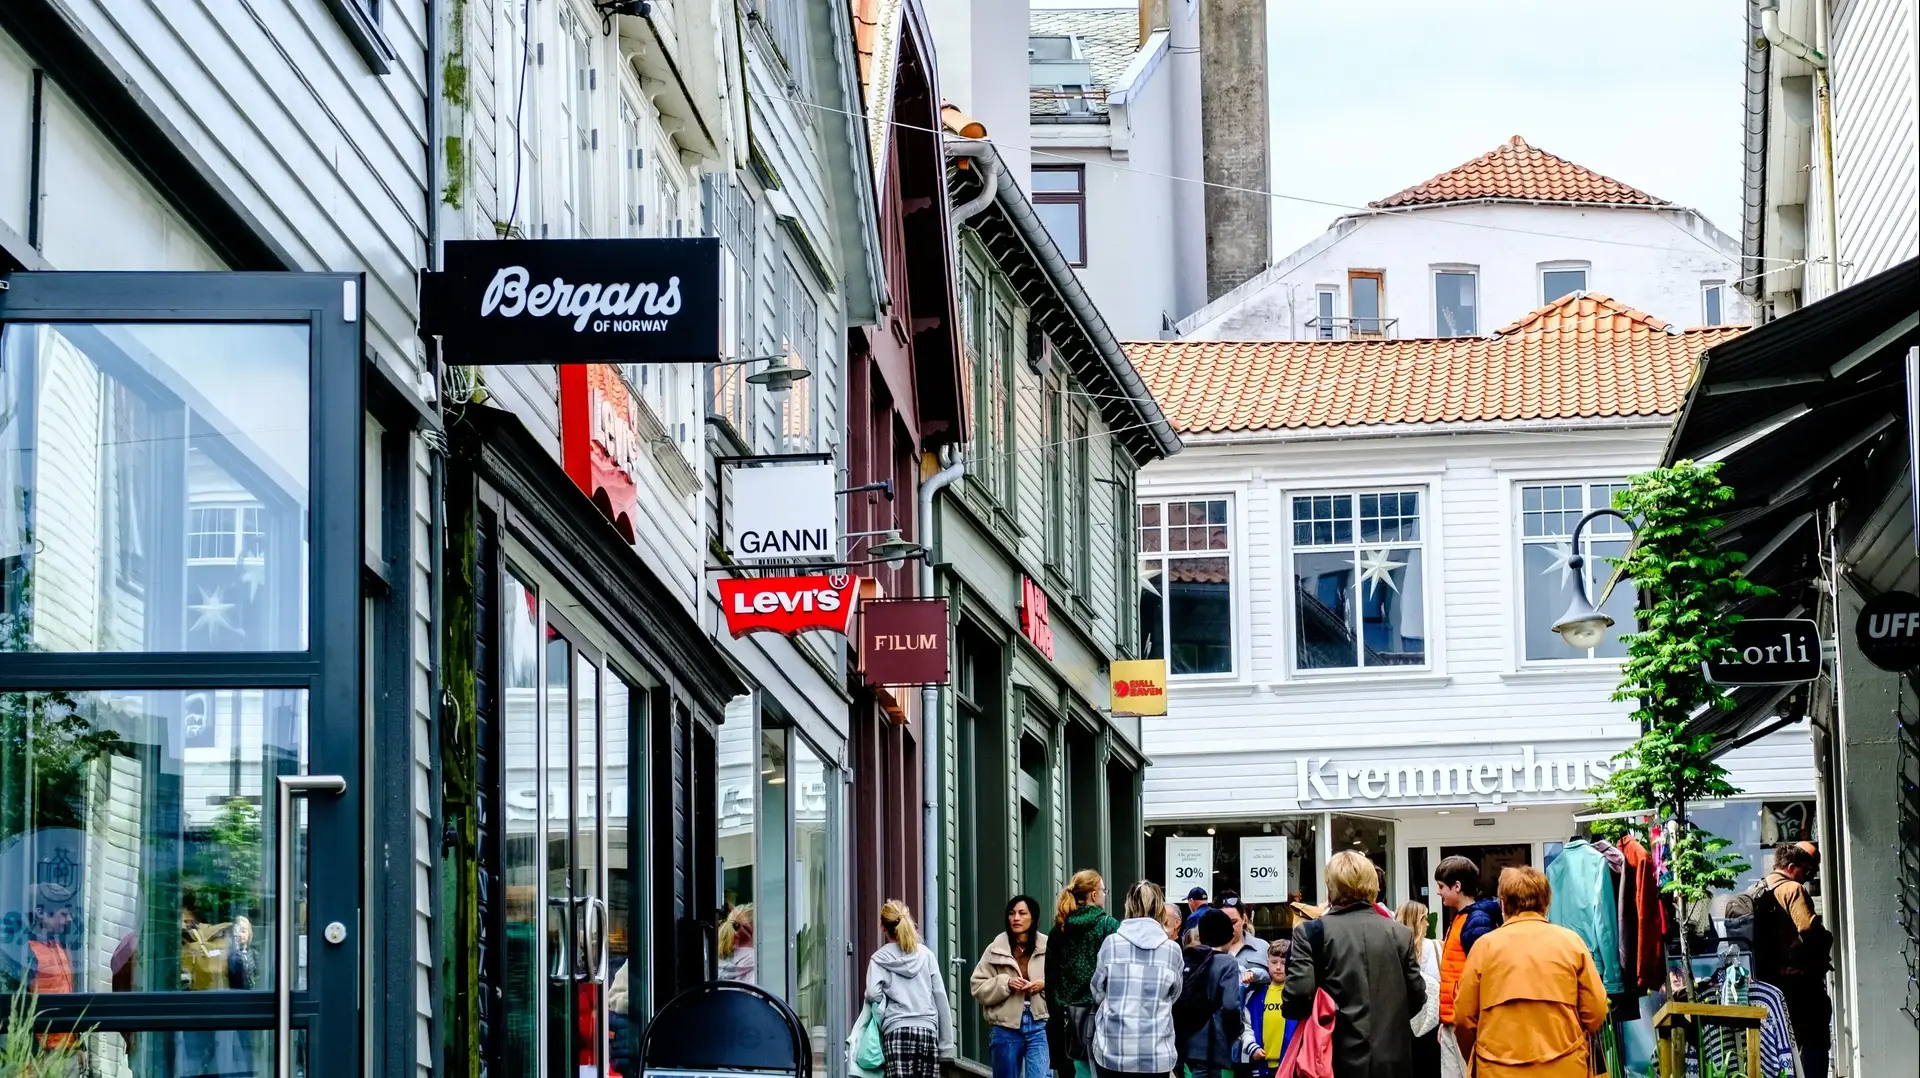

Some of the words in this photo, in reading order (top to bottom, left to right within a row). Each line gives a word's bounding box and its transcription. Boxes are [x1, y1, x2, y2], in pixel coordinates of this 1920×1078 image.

[481, 265, 681, 332] Bergans
[593, 320, 610, 332] OF
[613, 320, 668, 332] NORWAY
[739, 528, 828, 554] GANNI
[1868, 612, 1920, 639] UFF
[874, 634, 938, 651] FILUM
[1175, 867, 1204, 878] 30%
[1250, 867, 1279, 878] 50%
